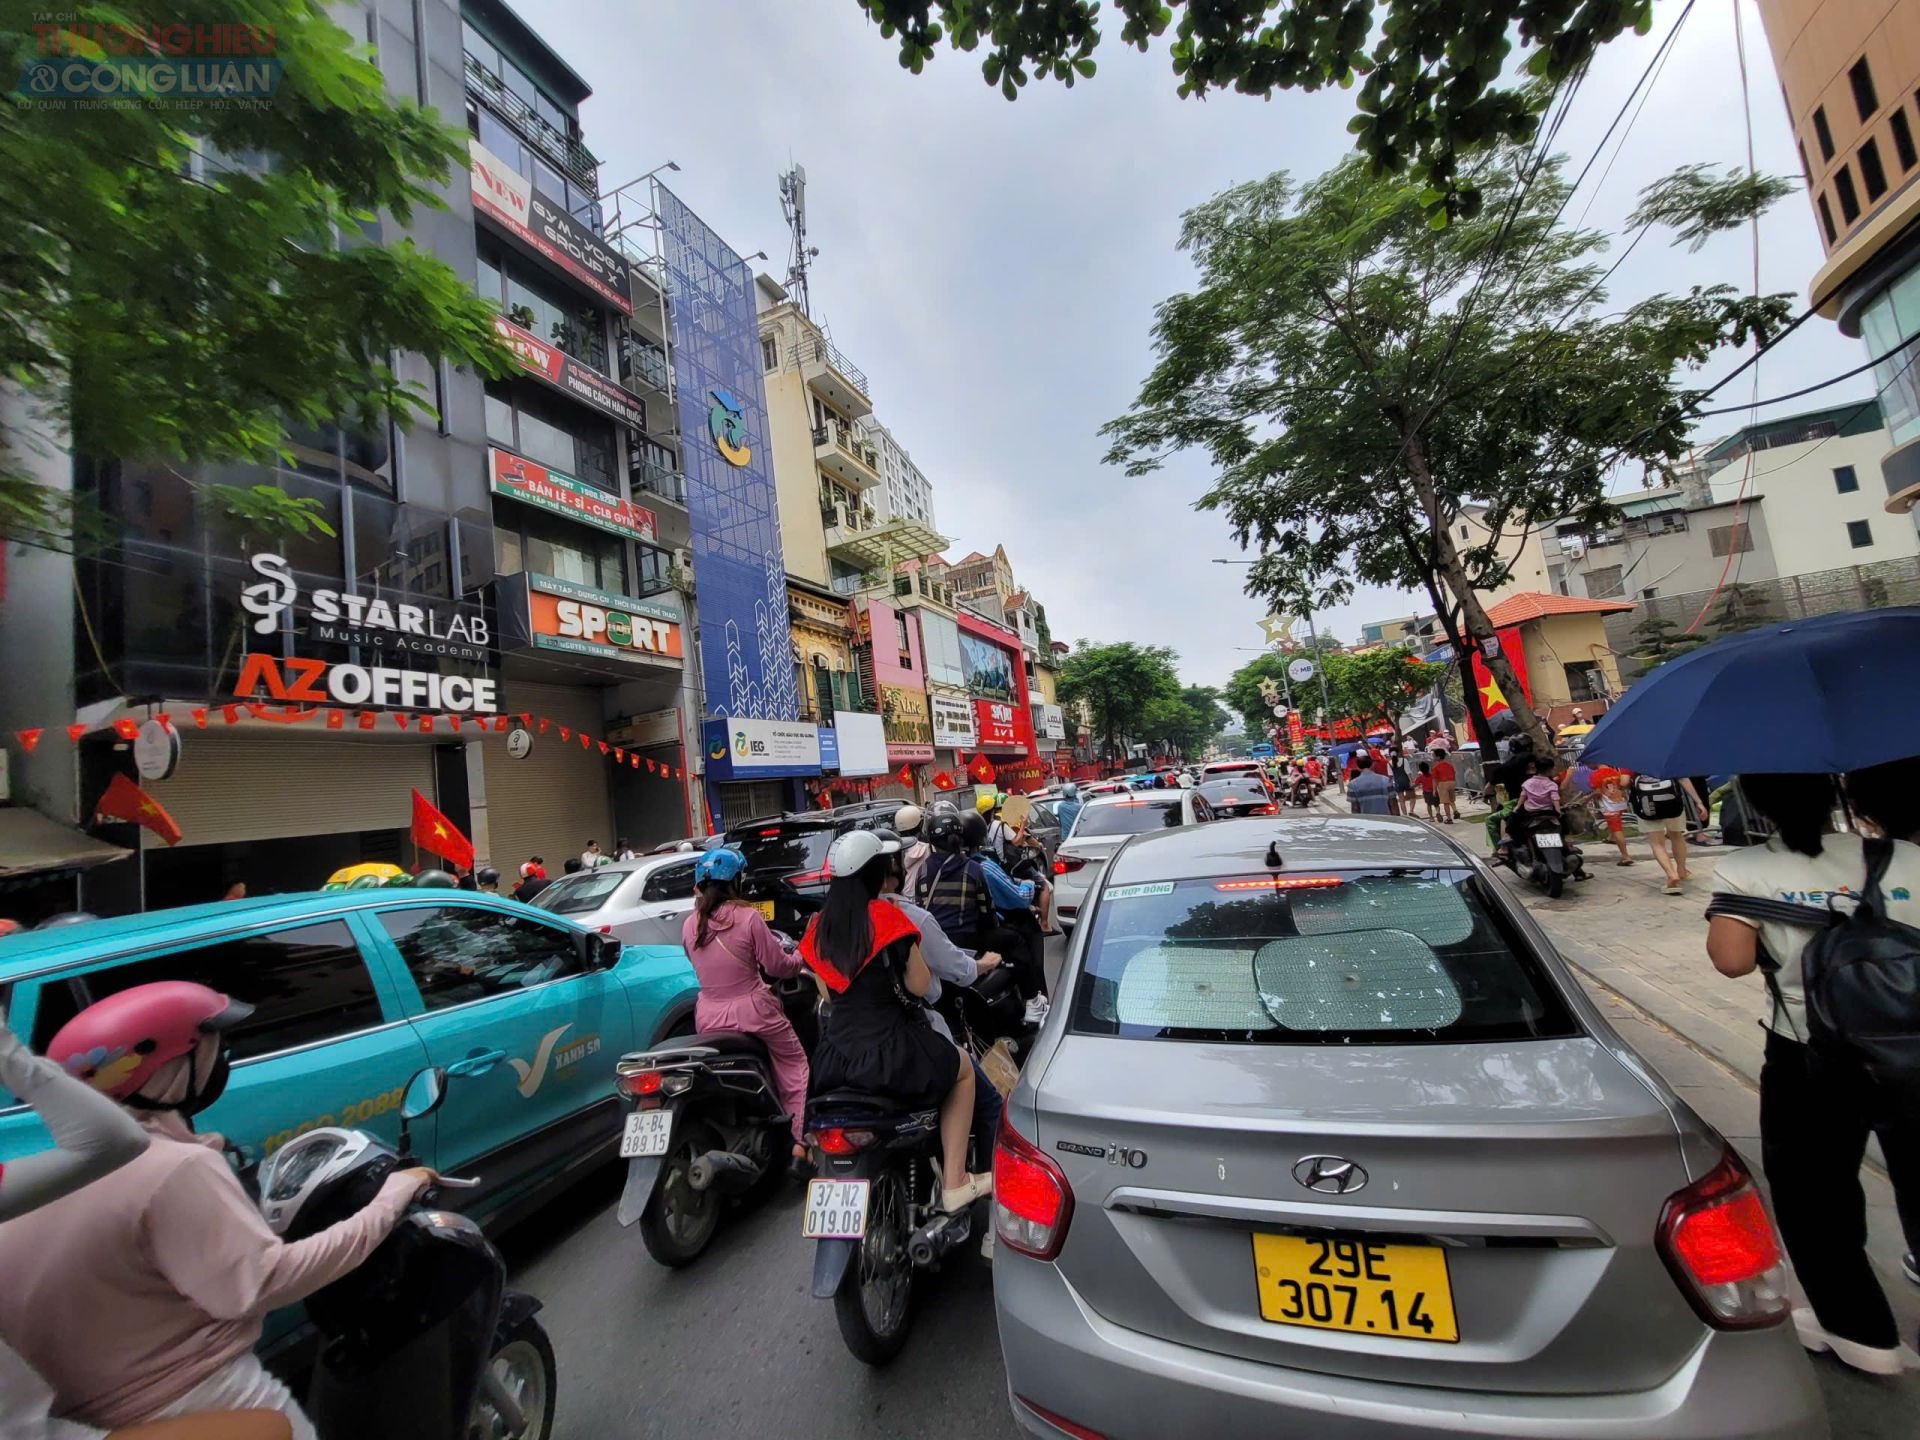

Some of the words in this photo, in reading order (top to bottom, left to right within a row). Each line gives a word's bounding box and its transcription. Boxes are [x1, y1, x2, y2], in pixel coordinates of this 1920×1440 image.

[475, 160, 526, 213] NEW
[532, 200, 573, 239] GYM
[584, 238, 627, 280] YOGA
[544, 225, 604, 273] GROUP
[607, 273, 618, 287] X
[568, 376, 592, 398] PHONG
[549, 474, 574, 490] SPORT
[529, 480, 553, 499] BÁN
[593, 504, 612, 520] CLB
[614, 512, 635, 528] GYM
[310, 588, 490, 646] STARLAB
[556, 600, 671, 654] SPORT
[319, 626, 384, 646] Music
[396, 629, 484, 661] Academy
[1300, 665, 1312, 673] MB
[750, 740, 765, 753] IEG
[1106, 889, 1119, 898] XE
[555, 1044, 585, 1070] XANH
[631, 1115, 664, 1134] 34-B4
[624, 1133, 667, 1154] 389.15
[1058, 1142, 1103, 1156] GRAND
[1107, 1142, 1148, 1169] i10
[815, 1183, 860, 1207] 37-N2
[807, 1210, 862, 1234] 019.08
[1305, 1236, 1391, 1282] 29E
[1278, 1279, 1434, 1334] 307.14
